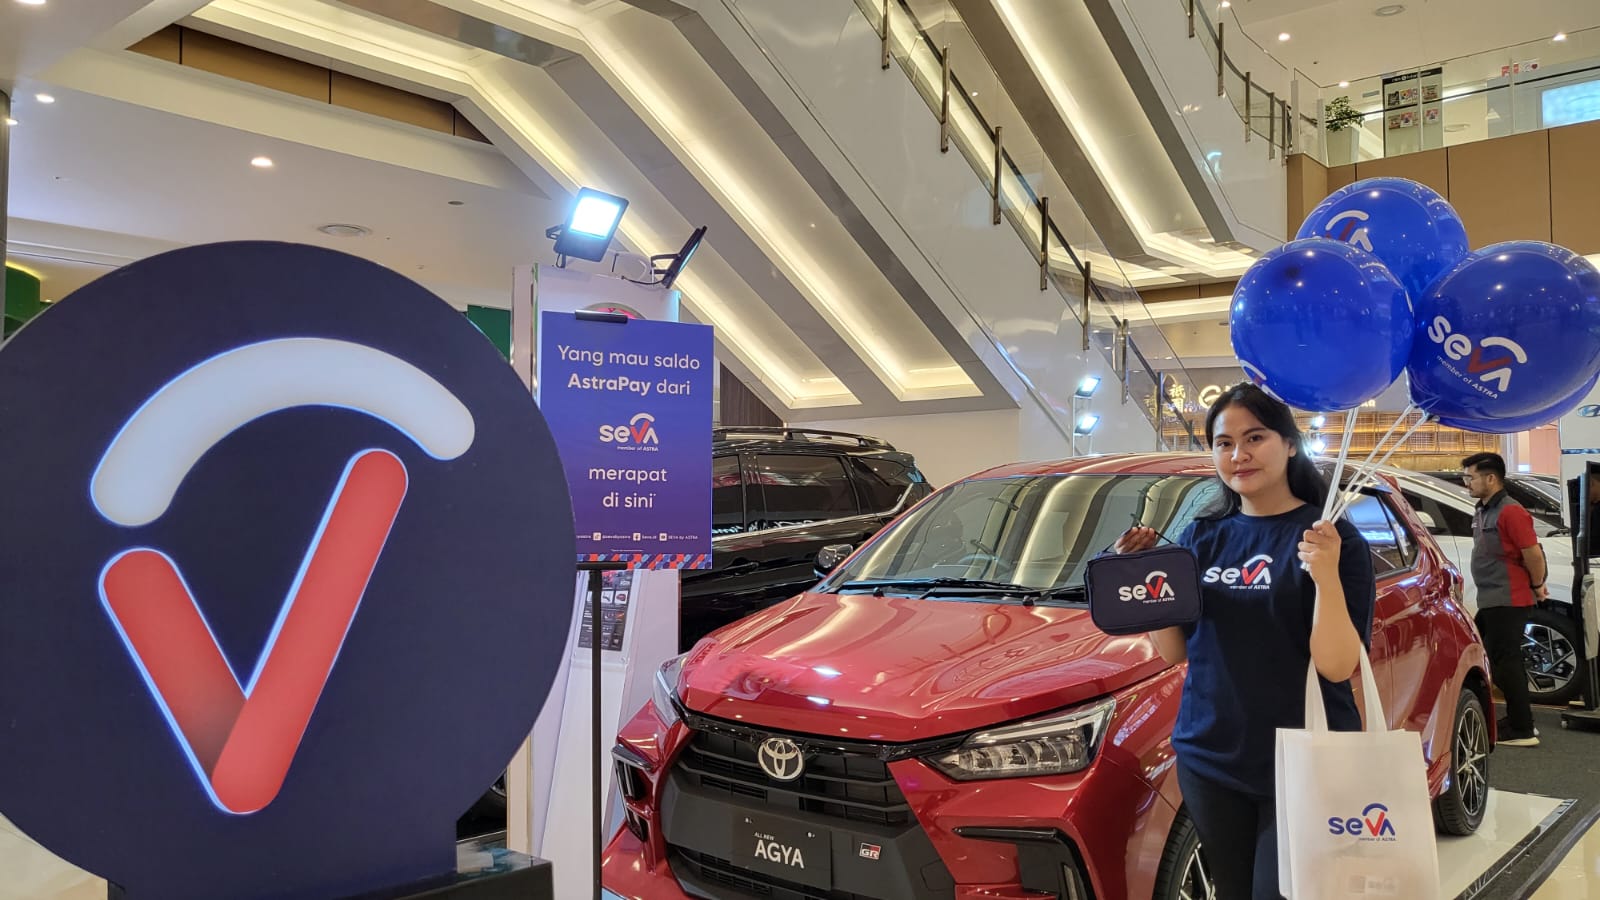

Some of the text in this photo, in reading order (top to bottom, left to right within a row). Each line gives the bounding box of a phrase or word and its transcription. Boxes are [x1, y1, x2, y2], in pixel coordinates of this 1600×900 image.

[558, 345, 700, 370] Yang mau saldo
[568, 373, 691, 396] AstraPay dari
[1437, 355, 1498, 399] member of ASTRA
[589, 466, 667, 484] merapat
[603, 492, 619, 508] di
[754, 839, 805, 869] AGYA
[861, 848, 879, 859] GR
